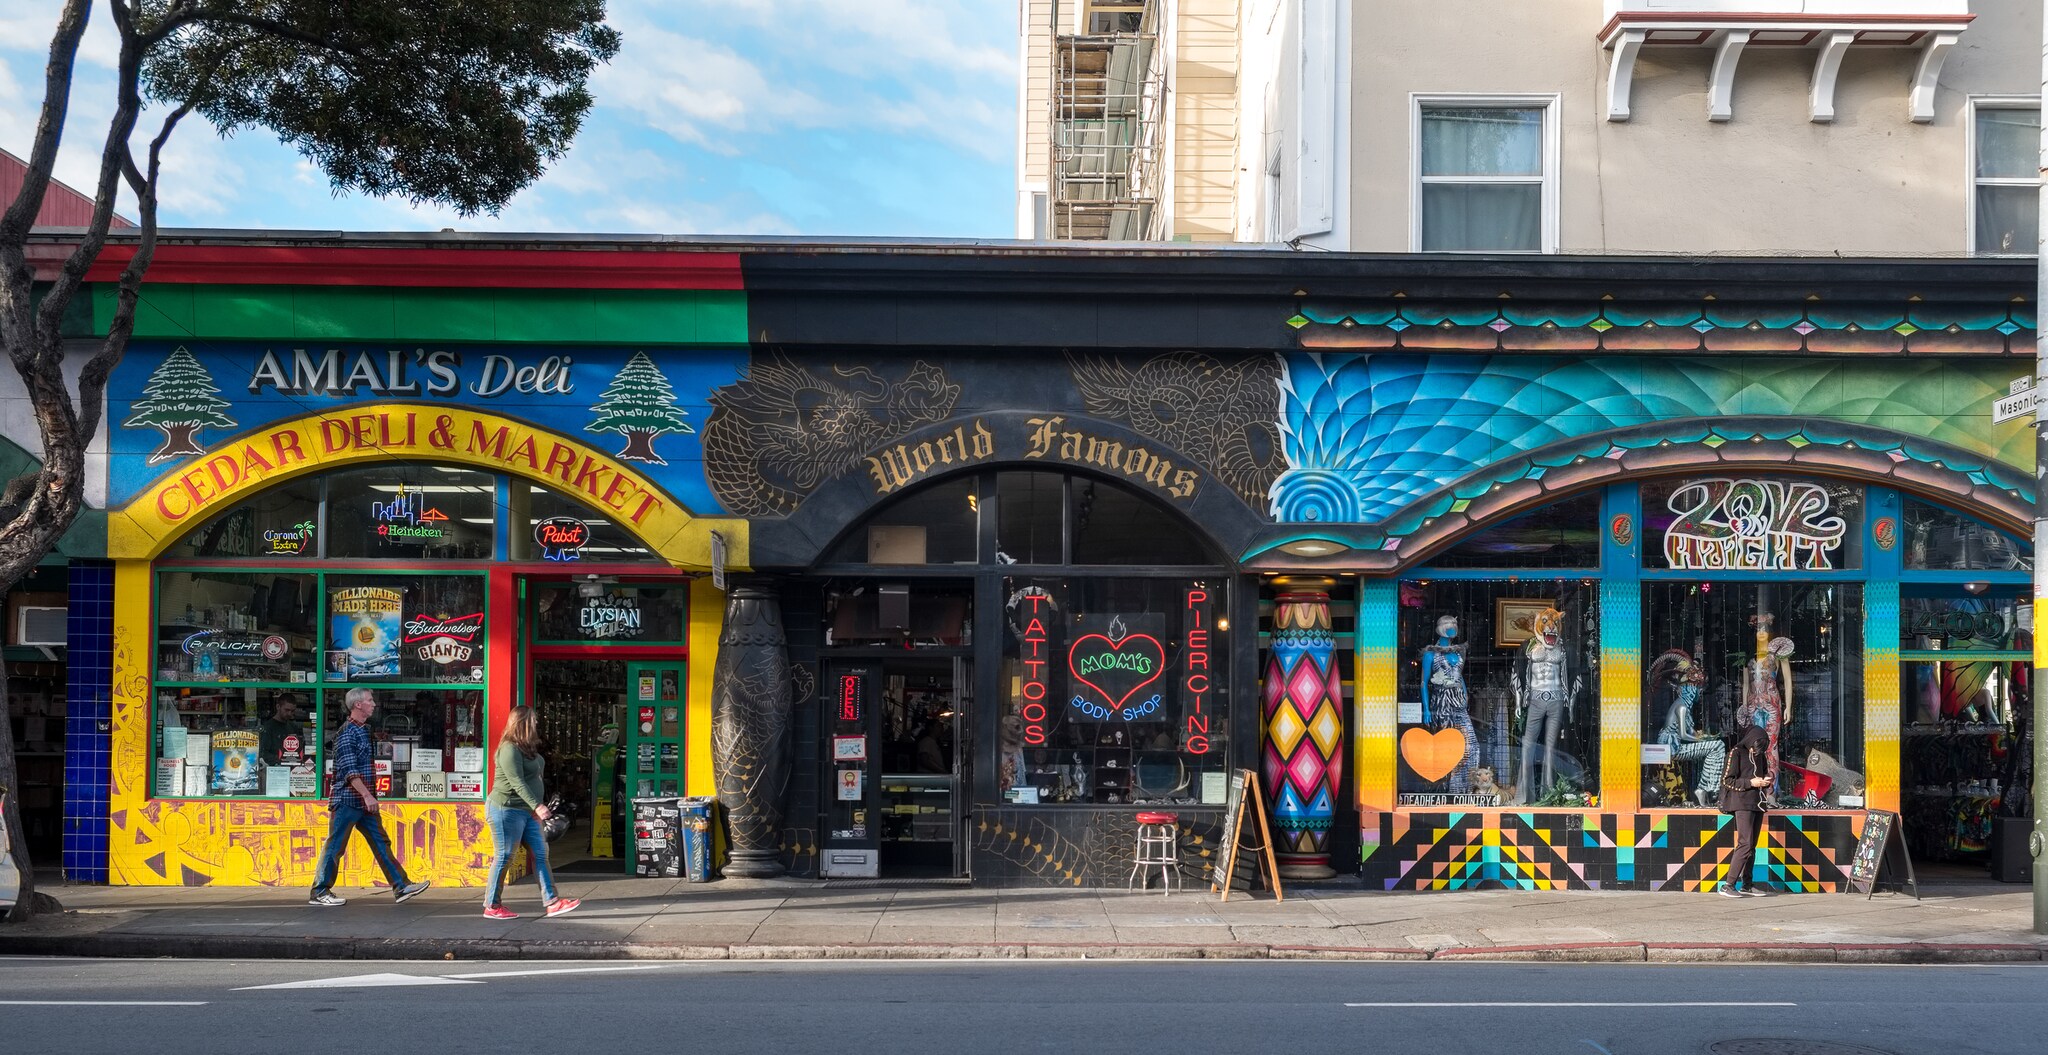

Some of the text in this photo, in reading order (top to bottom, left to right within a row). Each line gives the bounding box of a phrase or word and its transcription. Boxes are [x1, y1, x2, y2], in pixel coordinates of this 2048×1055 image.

[248, 348, 575, 396] AMAL'S Deli
[2000, 393, 2038, 417] Masonic
[864, 415, 1199, 499] World Famous
[157, 412, 663, 525] CEDAR DELI & MARKET
[263, 529, 299, 542] Corona
[388, 524, 443, 538] Heineken
[542, 524, 582, 544] Pabst
[273, 539, 298, 550] Extra
[332, 586, 401, 603] MILLIONAIRE
[332, 600, 401, 613] MADE HERE
[580, 607, 641, 628] ELYSIAN
[404, 620, 481, 635] Budweiser
[219, 641, 261, 650] LIGHT
[419, 643, 471, 661] GIANTS
[1022, 595, 1046, 744] TATTOOS
[1080, 652, 1151, 675] MOM'S
[1186, 590, 1209, 755] PIERCING
[844, 677, 855, 719] OPEN
[1071, 694, 1162, 721] BODY SHOP
[212, 730, 259, 741] MILLIONAIRE
[212, 739, 259, 748] MADE HERE
[421, 773, 432, 783] NO
[409, 783, 444, 793] LOITERING
[1403, 795, 1494, 806] DEADHEAD COUNTRY
